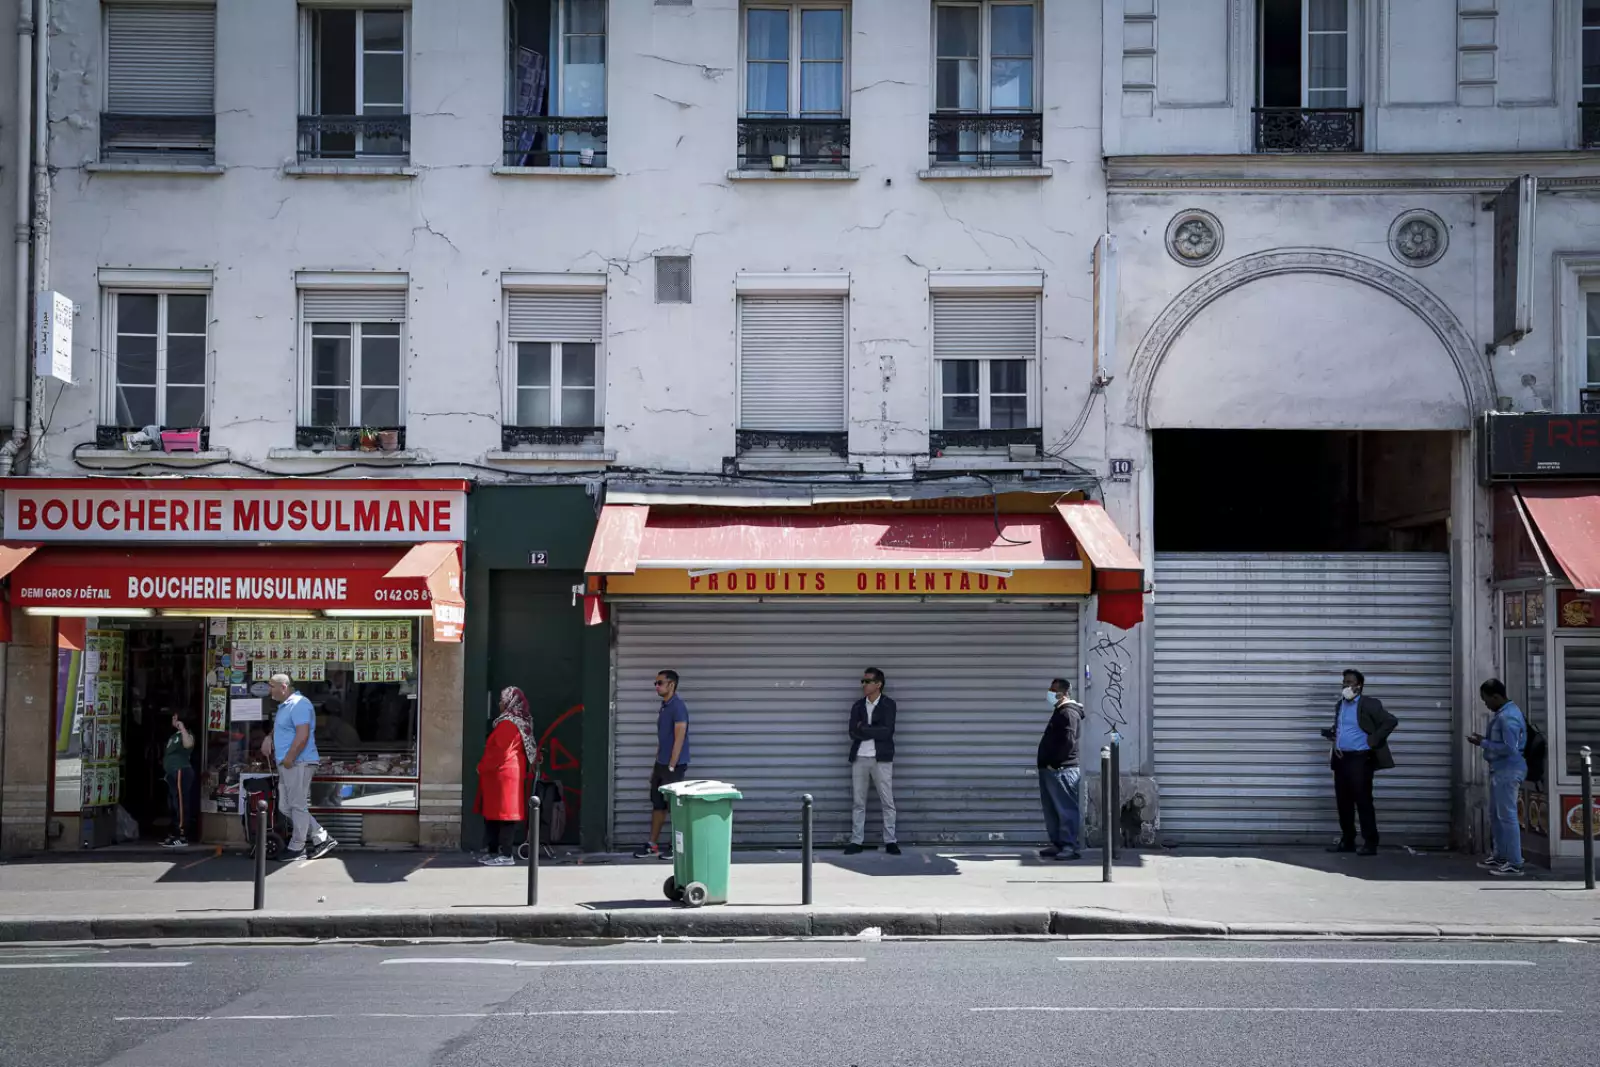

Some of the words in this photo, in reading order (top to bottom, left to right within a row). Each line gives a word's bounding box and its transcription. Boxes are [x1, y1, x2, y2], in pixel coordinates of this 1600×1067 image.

[1115, 461, 1129, 473] 10
[18, 498, 222, 531] BOUCHERIE
[233, 499, 451, 532] MUSULMANE
[531, 553, 545, 564] 12
[128, 576, 231, 600] BOUCHERIE
[236, 577, 347, 600] MUSULMANE
[690, 572, 825, 590] PRODUITS
[857, 572, 1008, 590] ORIENTAUX
[21, 587, 44, 598] DEMI
[45, 588, 72, 599] GROS
[74, 588, 78, 599] /
[80, 585, 112, 599] DÉTAIL
[374, 589, 388, 600] 01
[389, 589, 402, 600] 42
[403, 589, 419, 600] 05
